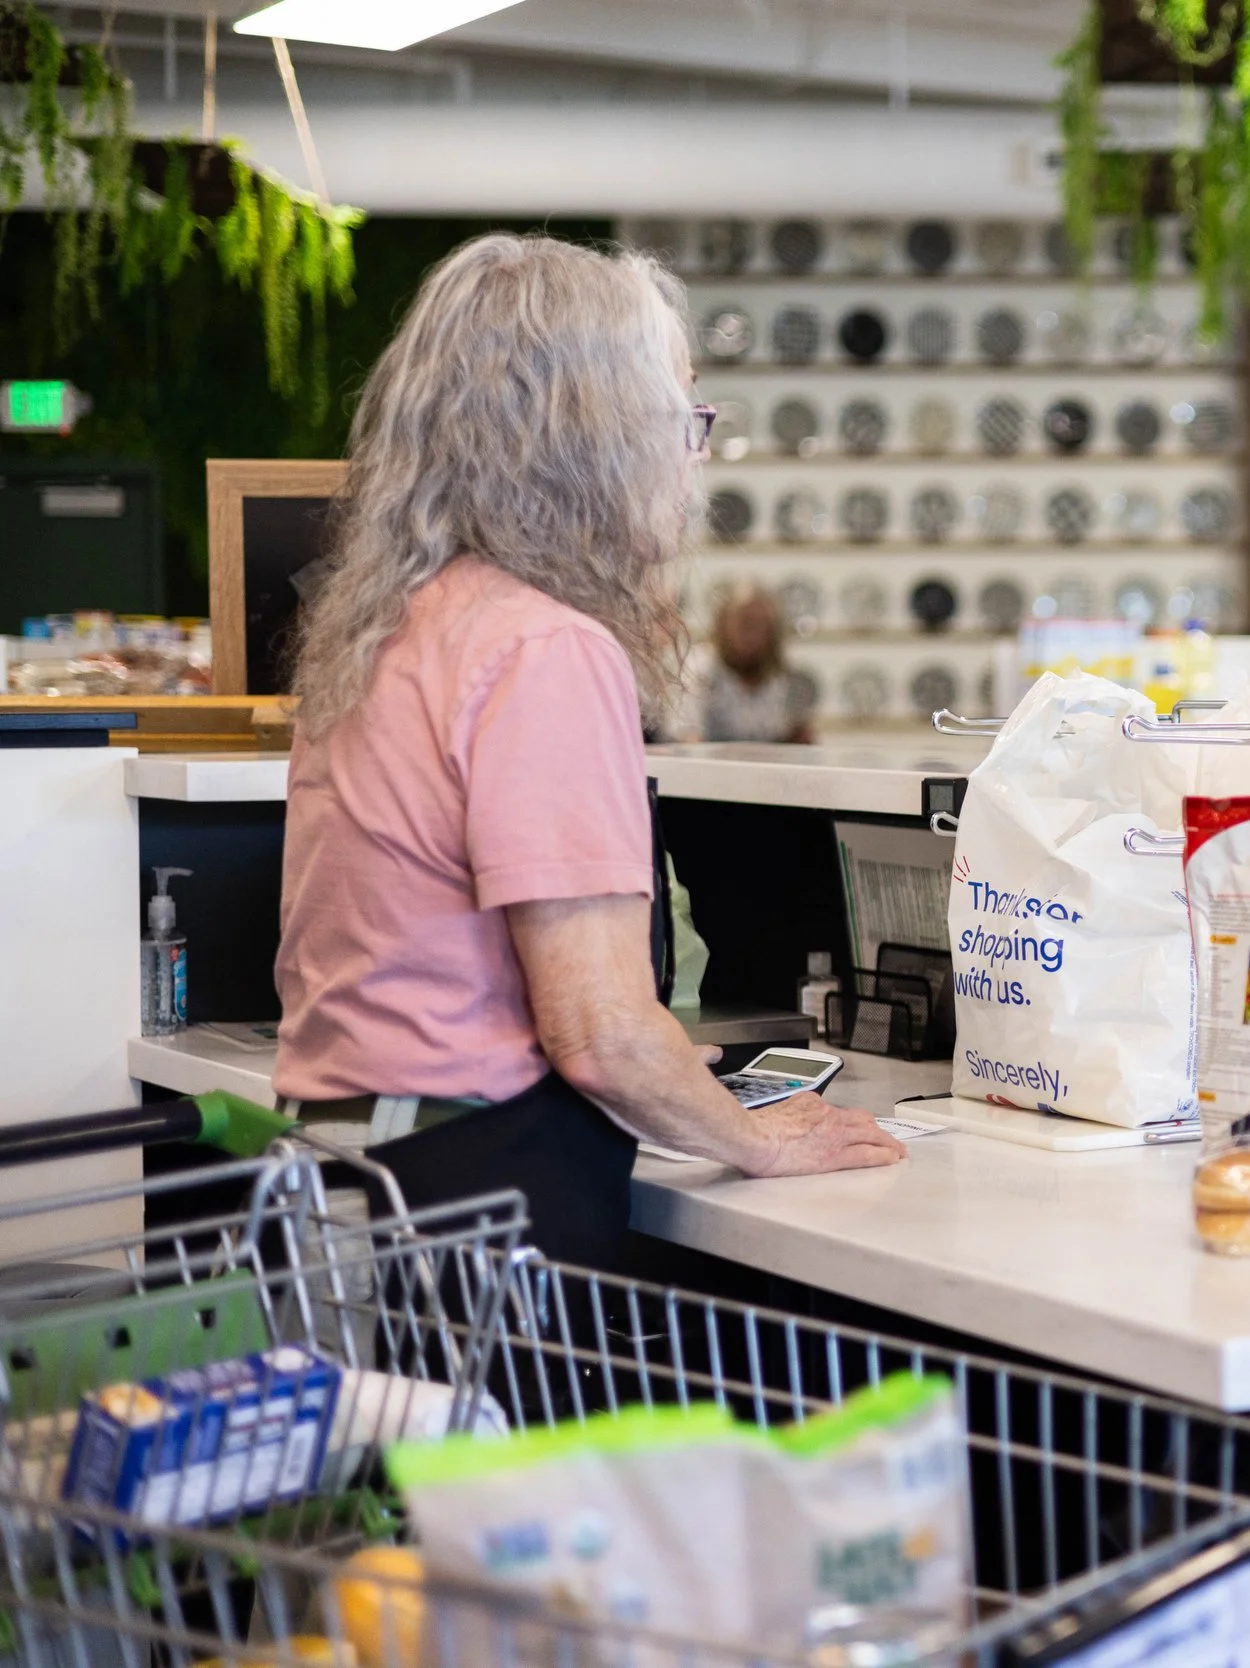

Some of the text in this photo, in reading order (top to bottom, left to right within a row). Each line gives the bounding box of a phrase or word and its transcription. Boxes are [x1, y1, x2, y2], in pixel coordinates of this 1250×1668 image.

[958, 925, 1064, 972] shopping
[954, 966, 1031, 1006] with us.
[965, 1050, 1068, 1101] Sincerely,
